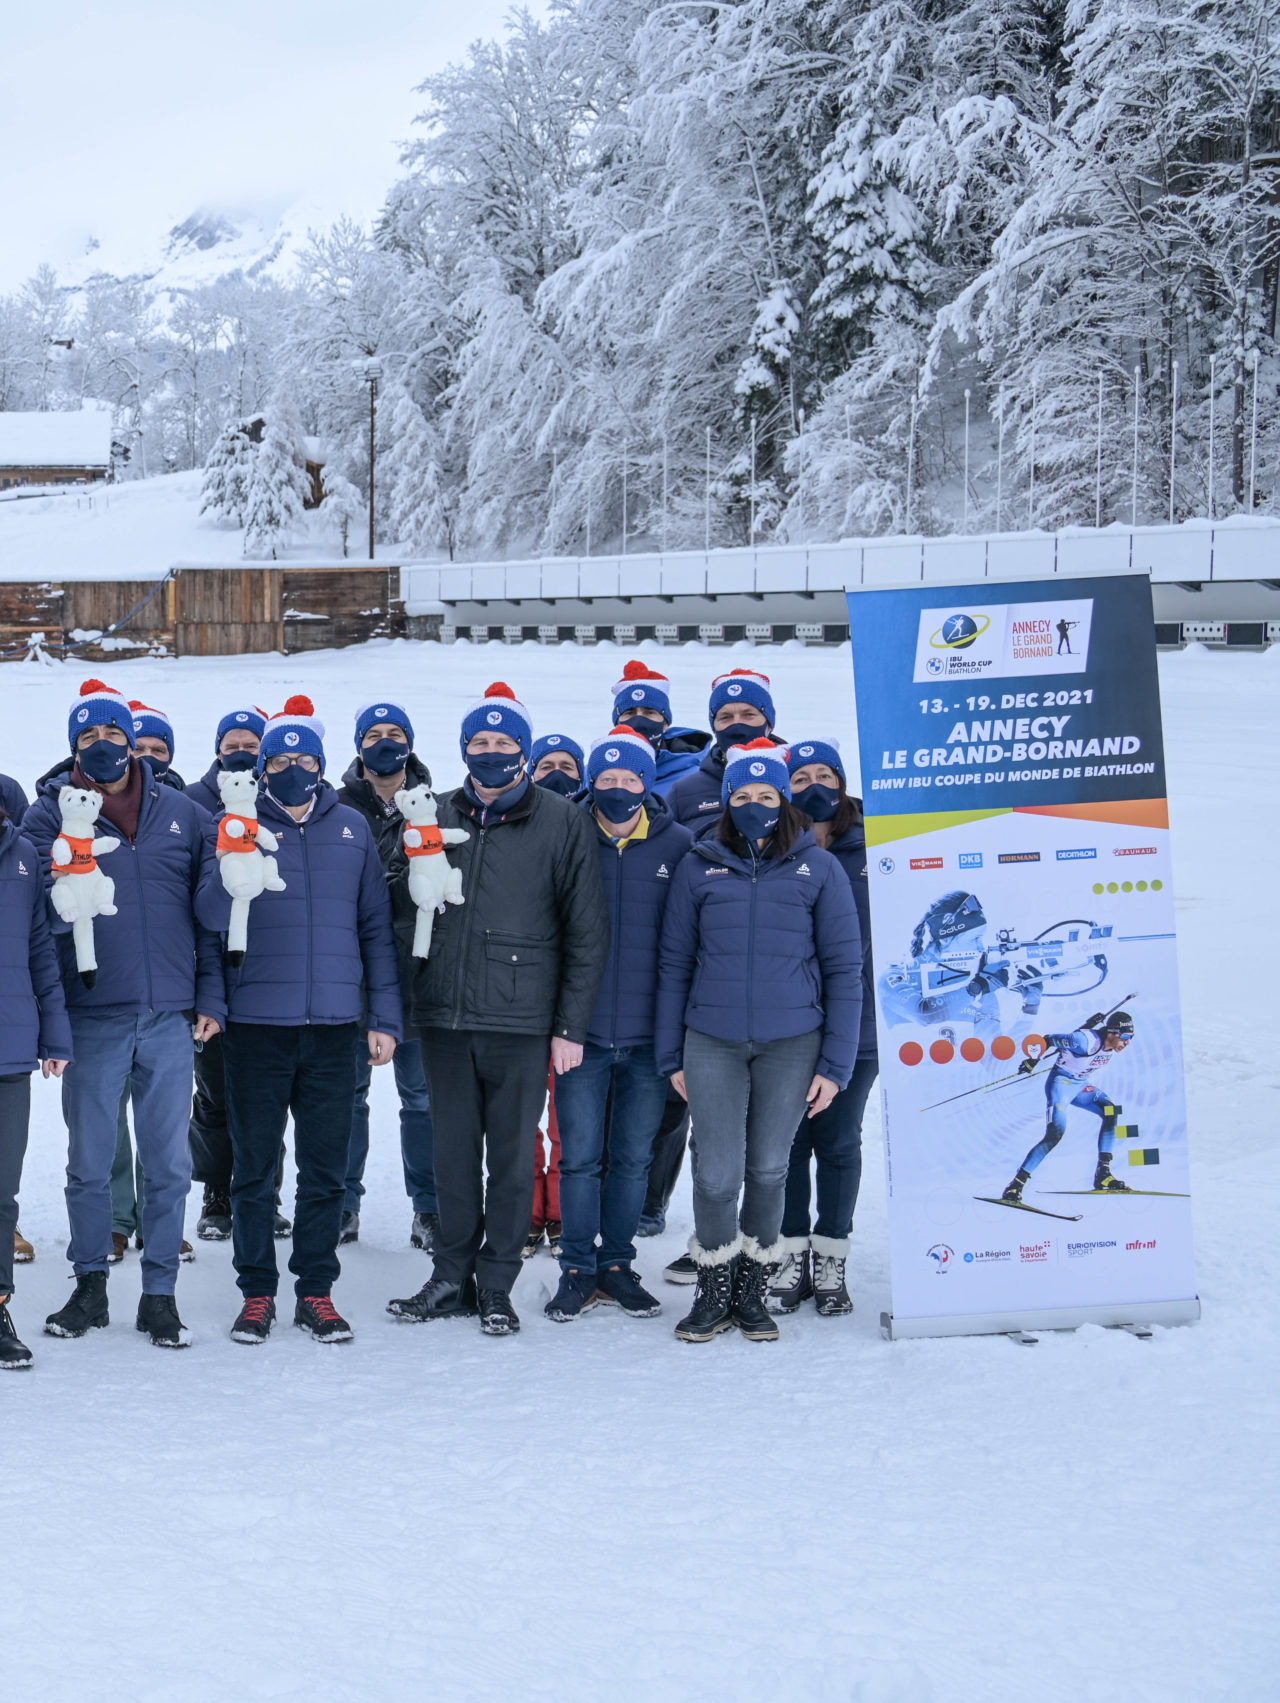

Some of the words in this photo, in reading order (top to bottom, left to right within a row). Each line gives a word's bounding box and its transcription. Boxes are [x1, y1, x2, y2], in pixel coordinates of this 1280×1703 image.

[1013, 620, 1050, 634] ANNECY
[1013, 635, 1021, 646] LE
[1023, 632, 1052, 647] GRAND
[1013, 645, 1053, 659] BORNAND
[949, 665, 982, 674] BIATHLON
[950, 660, 976, 669] WORLD
[919, 699, 948, 713] 13.
[966, 696, 995, 711] 19.
[1001, 693, 1038, 708] DEC
[1043, 690, 1093, 706] 2021
[946, 716, 1072, 744] ANNECY
[882, 750, 907, 769] LE
[913, 735, 1141, 768] GRAND-BORNAND
[872, 778, 906, 790] BMW
[908, 777, 931, 788] IBU
[935, 773, 981, 786] COUPE
[985, 772, 1004, 783] DU
[1008, 769, 1059, 781] MONDE
[1063, 767, 1081, 778] DE
[1084, 763, 1154, 777] BIATHLON
[960, 855, 981, 864] DKB
[986, 1250, 1011, 1259] Région
